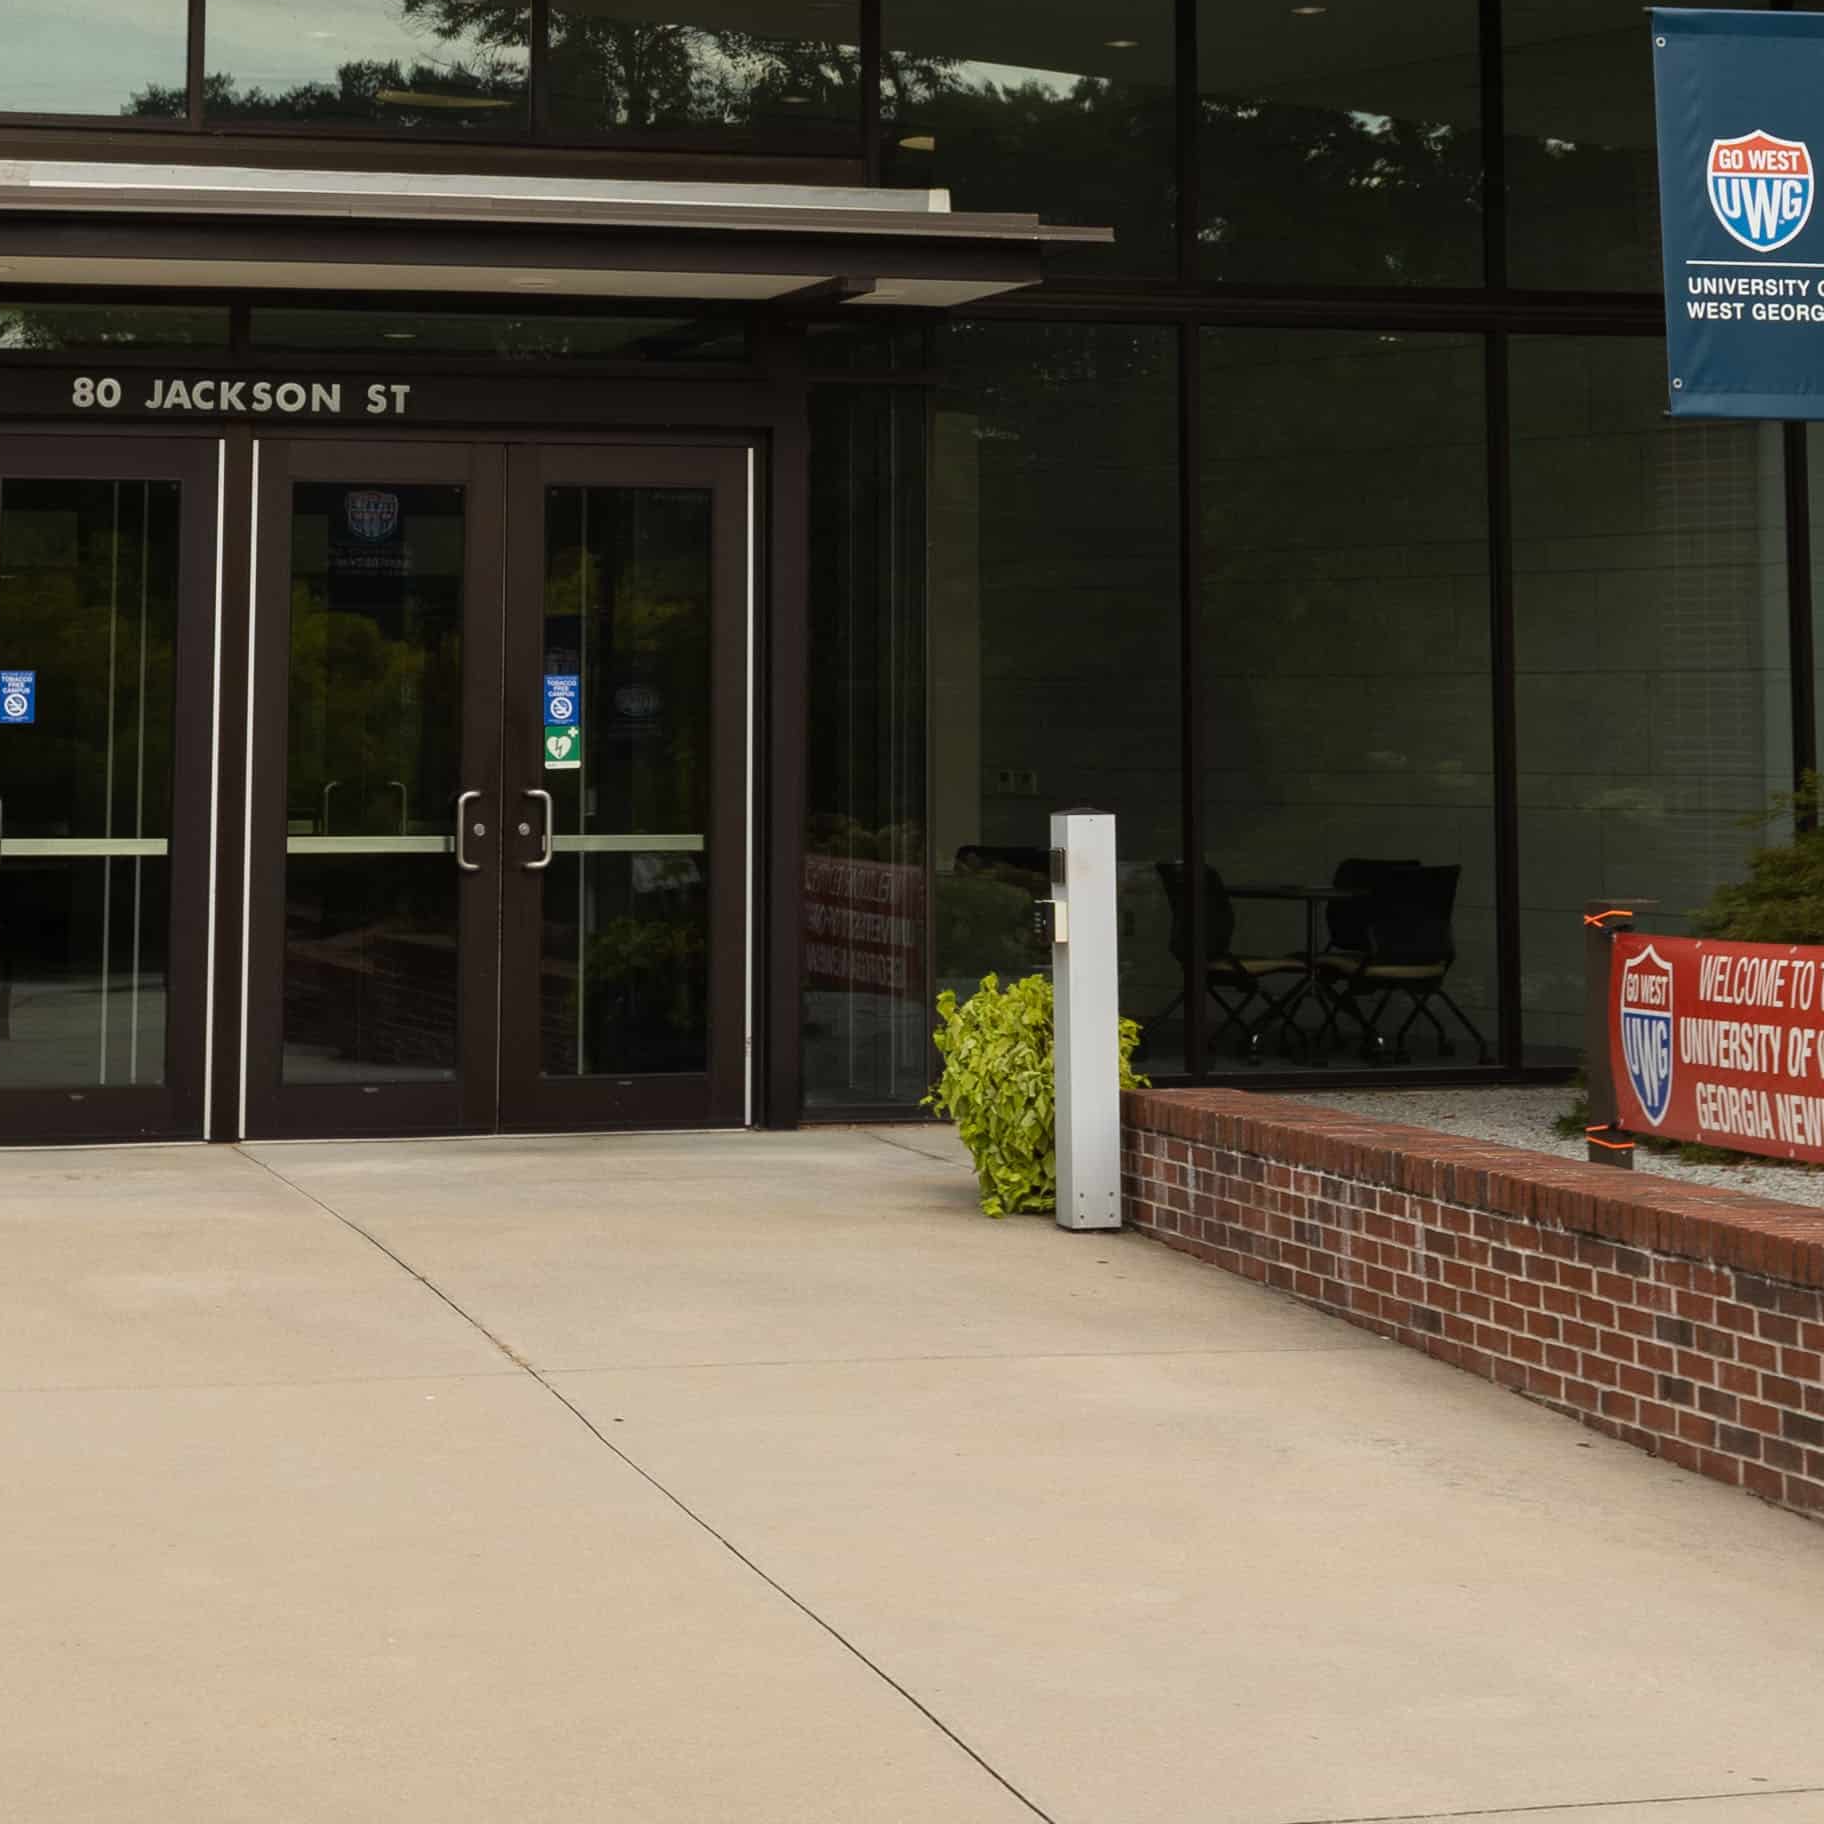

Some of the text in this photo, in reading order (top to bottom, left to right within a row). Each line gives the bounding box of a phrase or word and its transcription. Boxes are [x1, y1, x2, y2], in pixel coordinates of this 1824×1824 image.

[1718, 149, 1801, 172] GO WEST
[1717, 178, 1803, 240] UWG
[1688, 277, 1810, 297] UNIVERSITY
[1687, 302, 1745, 320] WEST
[72, 377, 411, 414] 80 JACKSON ST
[1626, 973, 1669, 1005] GO WEST
[1699, 954, 1789, 1008] WELCOME
[1791, 961, 1816, 1010] TO
[1626, 1017, 1668, 1107] UWG
[1680, 1017, 1782, 1074] UNIVERSITY
[1787, 1027, 1816, 1077] OF
[1695, 1082, 1776, 1140] GEORGIA
